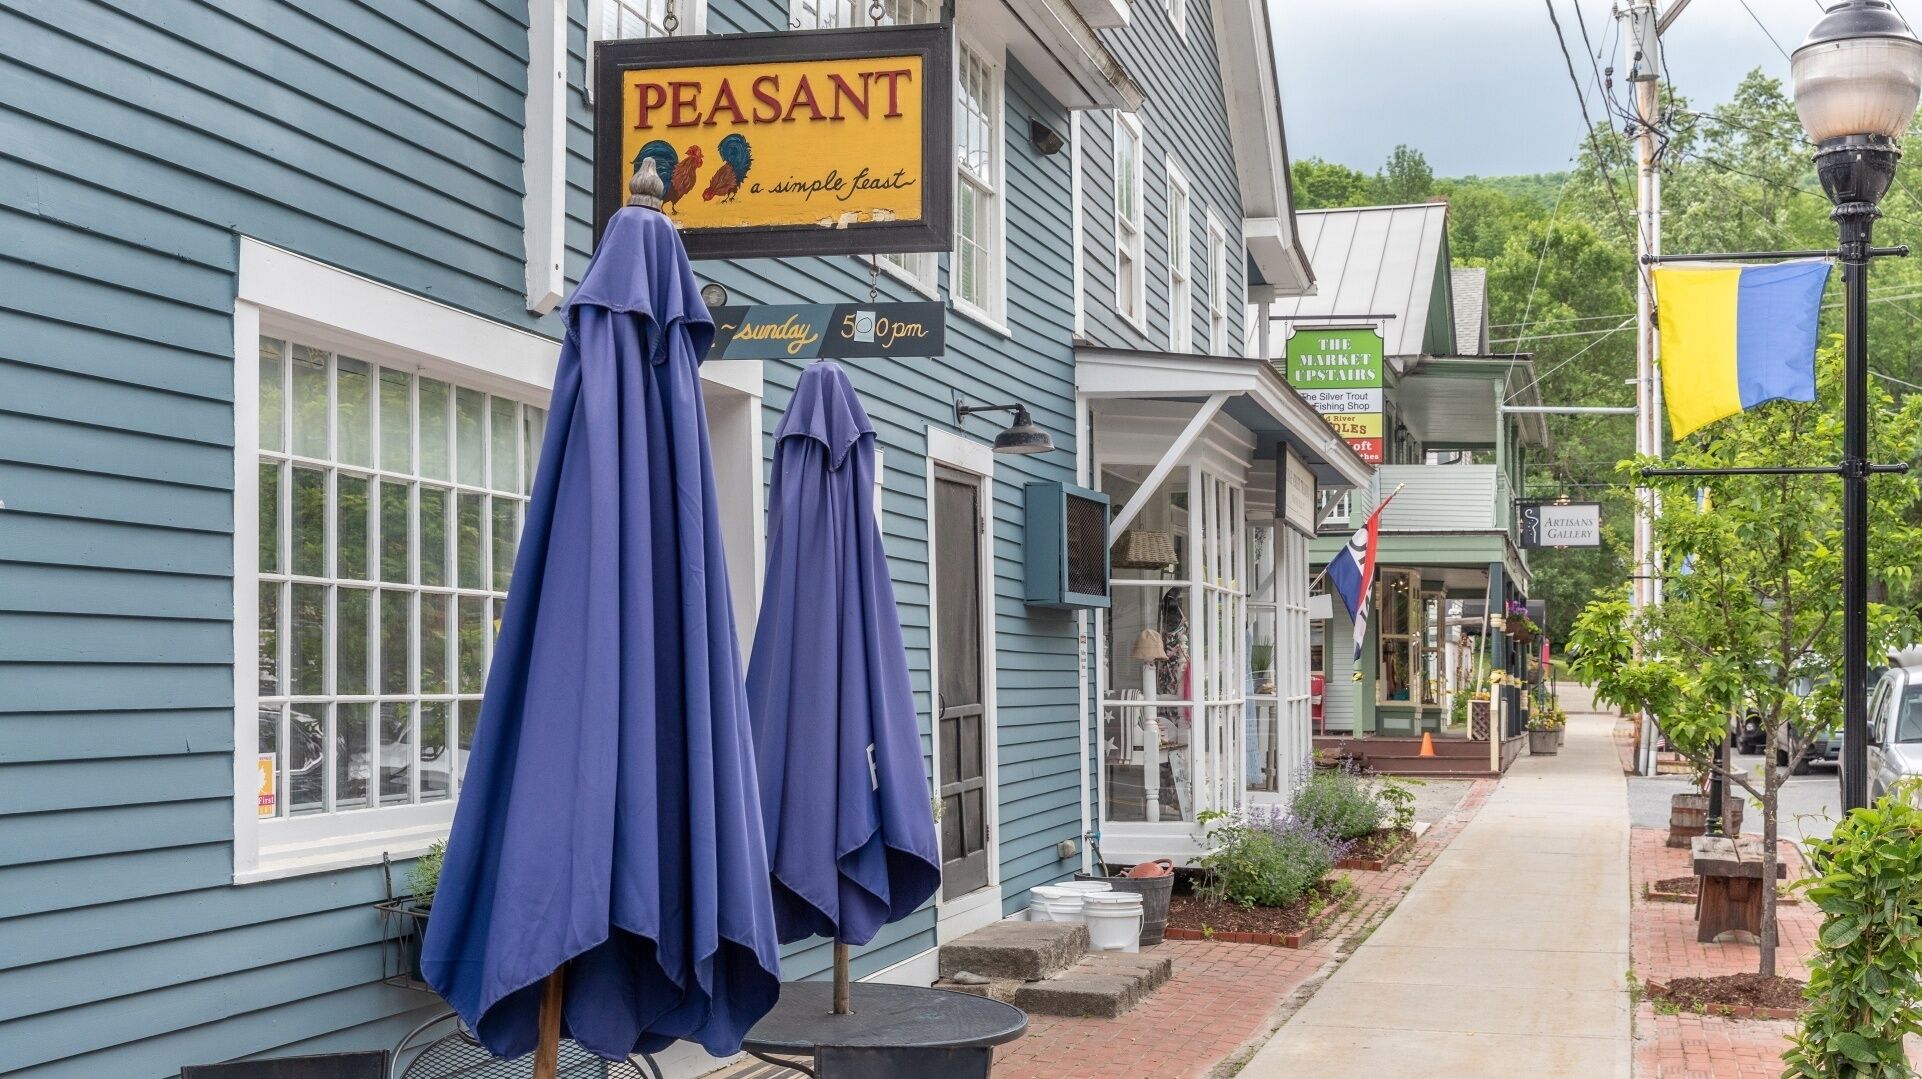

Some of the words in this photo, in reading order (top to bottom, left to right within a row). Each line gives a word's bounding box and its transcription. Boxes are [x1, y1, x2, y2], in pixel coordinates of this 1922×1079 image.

[634, 69, 912, 130] PEASANT
[750, 182, 764, 194] a
[769, 169, 847, 201] simple
[836, 167, 916, 201] feast
[1318, 338, 1352, 351] THE
[1299, 353, 1372, 366] MARKET
[1295, 368, 1376, 382] UPSTAIRS
[1301, 392, 1317, 401] The
[1319, 392, 1344, 401] Silver
[1346, 392, 1368, 401] Trout
[1347, 402, 1370, 411] Shop
[1331, 422, 1367, 434] DLES
[1347, 440, 1373, 451] oft
[1544, 517, 1594, 527] ARTISANS
[1547, 528, 1593, 539] GALLERY
